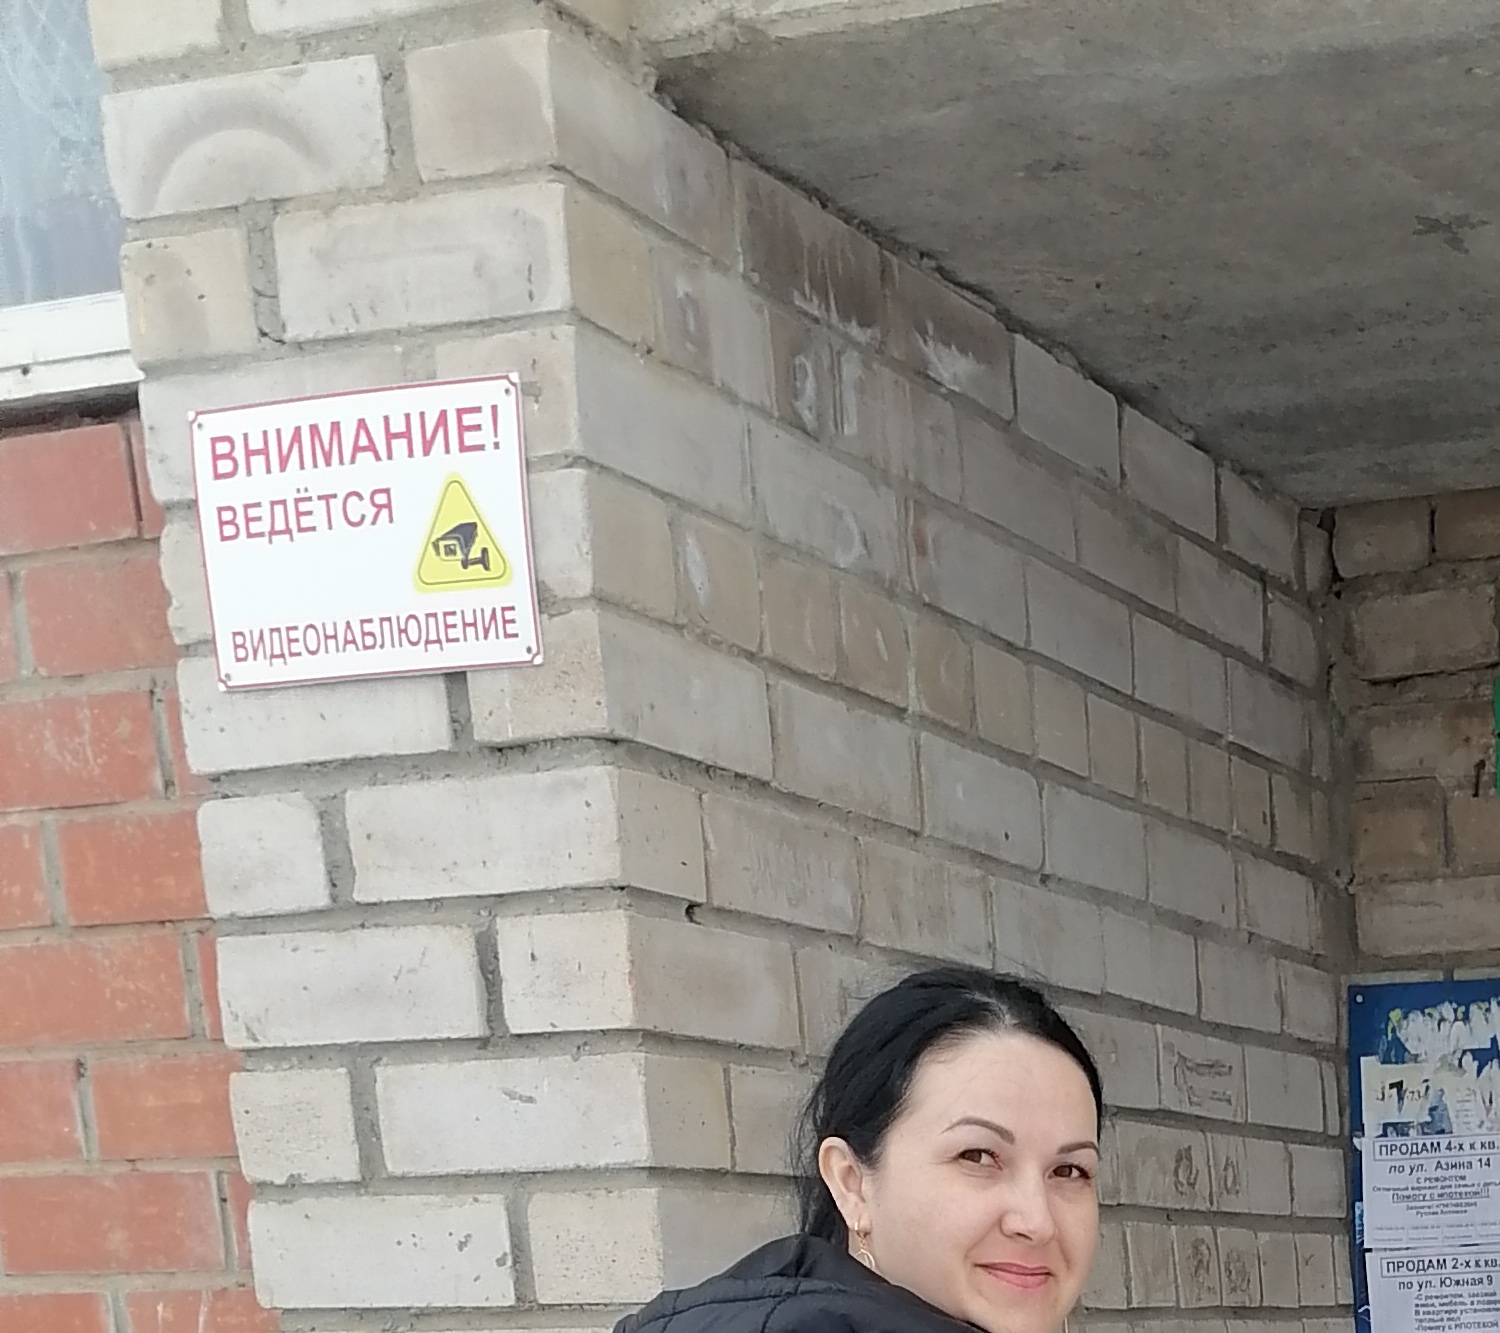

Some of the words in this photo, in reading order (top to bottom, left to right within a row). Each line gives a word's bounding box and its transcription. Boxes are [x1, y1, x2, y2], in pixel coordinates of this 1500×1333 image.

[209, 405, 501, 481] ВНИМАНИЕ!
[216, 487, 396, 545] ВЕДЁТСЯ
[231, 605, 520, 667] ВИДЕОНАБЛЮДЕНИЕ
[1378, 1140, 1442, 1157] ПРОДАМ
[1444, 1140, 1466, 1152] 4-х
[1388, 1164, 1405, 1175] по
[1408, 1163, 1427, 1176] ул.
[1434, 1159, 1473, 1172] Азина
[1477, 1157, 1492, 1169] 14
[1386, 1258, 1448, 1274] ПРОДАМ
[1451, 1257, 1471, 1270] 2-х
[1398, 1281, 1414, 1291] по
[1416, 1279, 1436, 1292] ул.
[1439, 1276, 1484, 1288] Южная
[1486, 1275, 1494, 1286] 9
